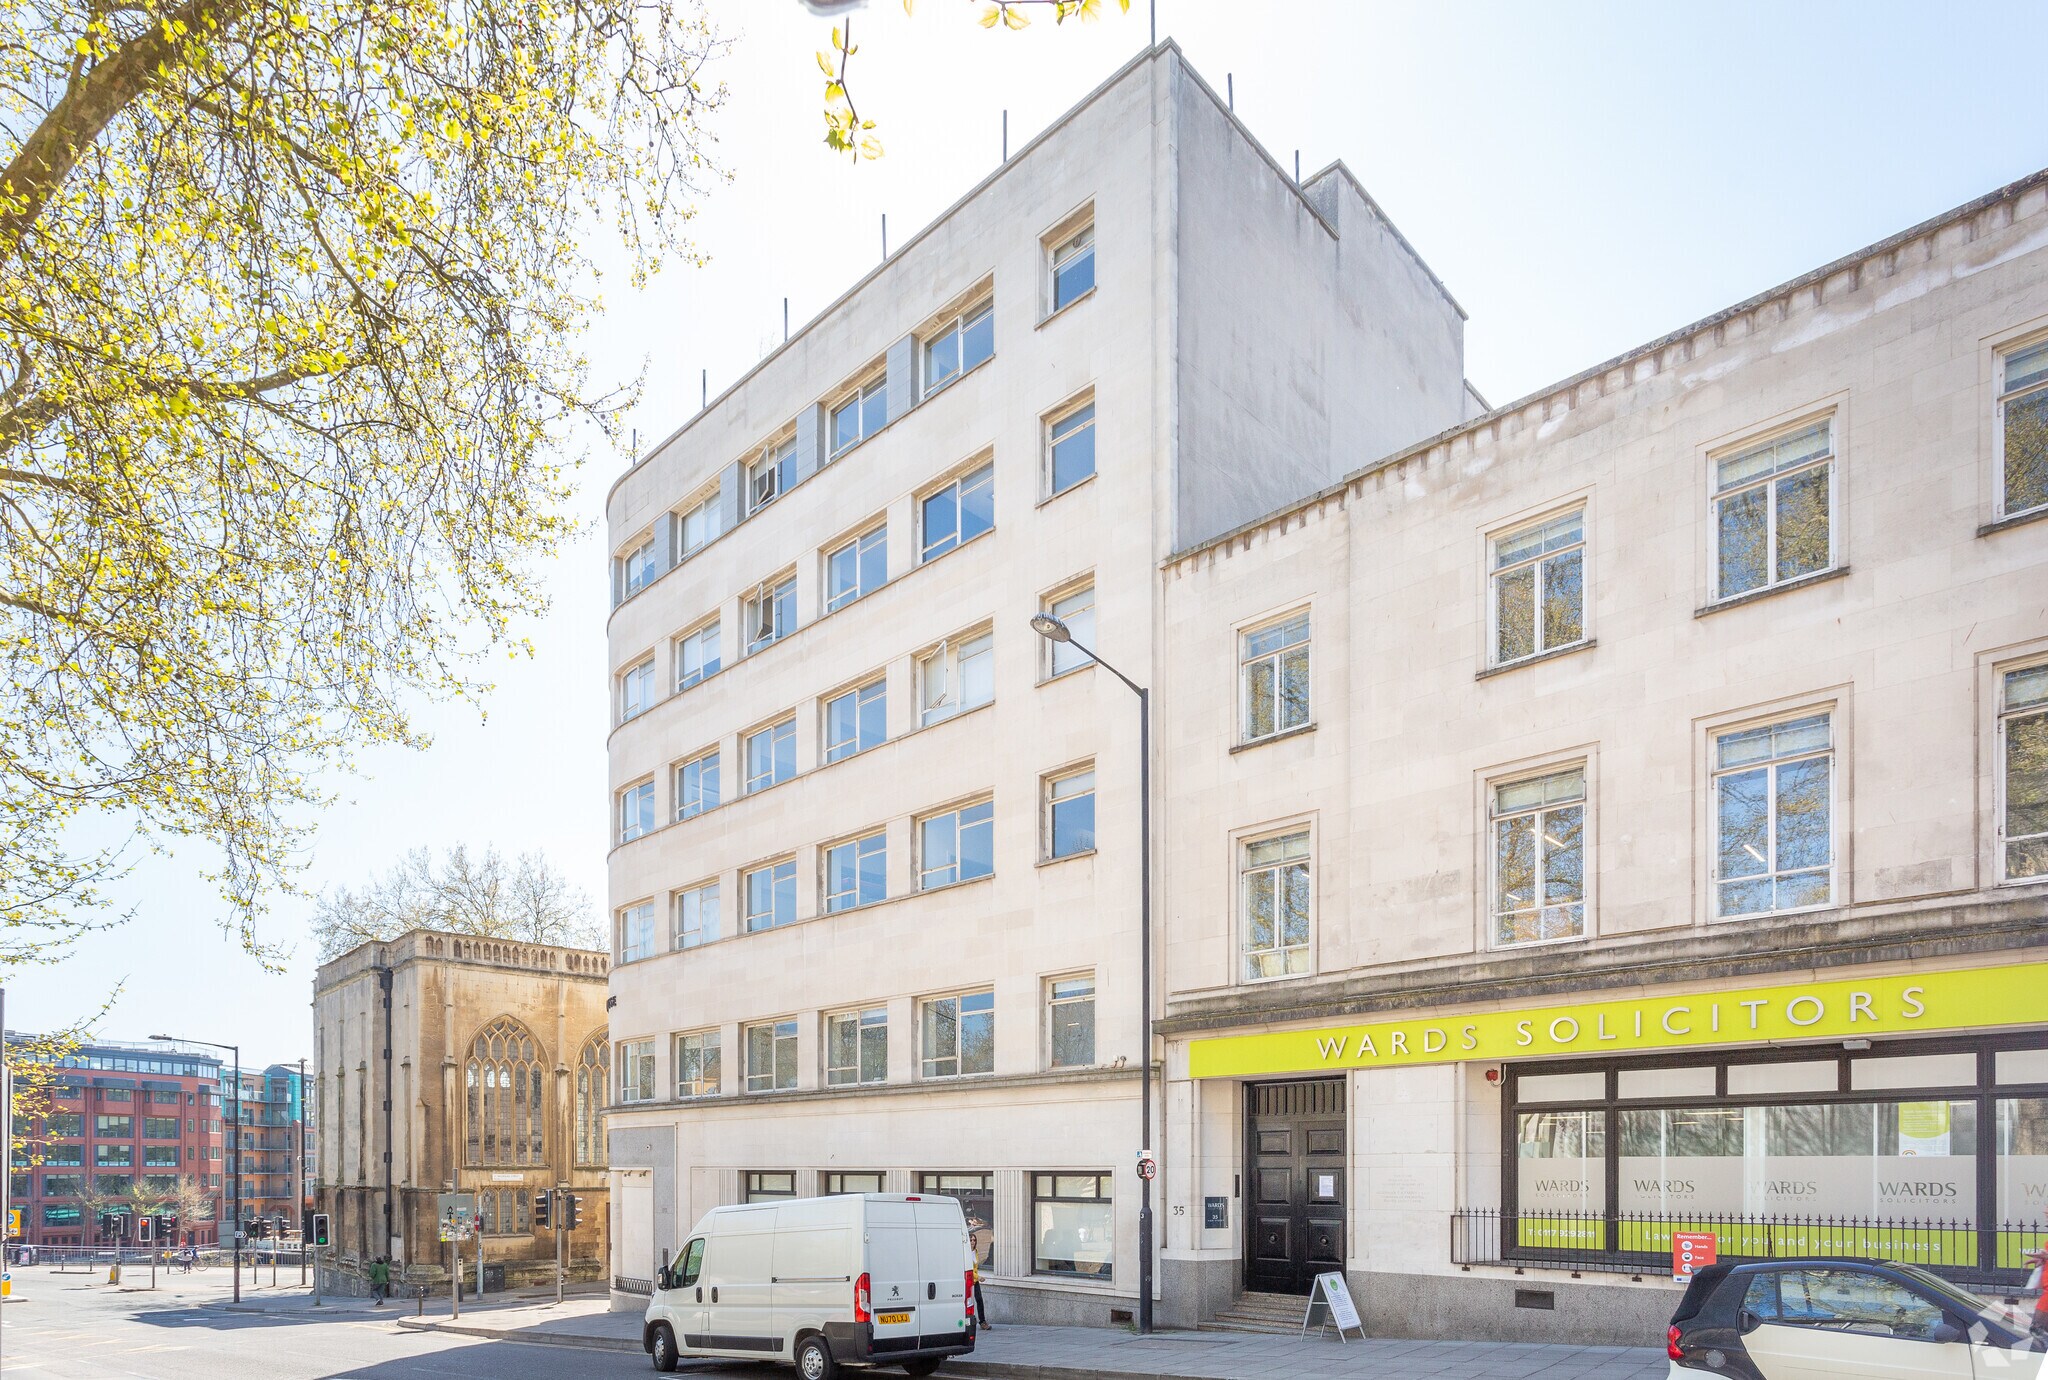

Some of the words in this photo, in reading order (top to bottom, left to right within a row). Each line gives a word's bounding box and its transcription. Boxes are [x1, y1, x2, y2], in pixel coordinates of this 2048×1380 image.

[1316, 1025, 1478, 1060] WARDS
[1516, 986, 1926, 1046] SOLICITORS
[1146, 1165, 1155, 1174] 20
[1535, 1179, 1590, 1192] WARDS
[1633, 1179, 1696, 1193] WARDS
[1878, 1182, 1957, 1197] WARDS
[1173, 1205, 1185, 1216] 35
[1742, 1236, 1770, 1247] you
[1778, 1236, 1806, 1247] and
[1863, 1238, 1941, 1251] business
